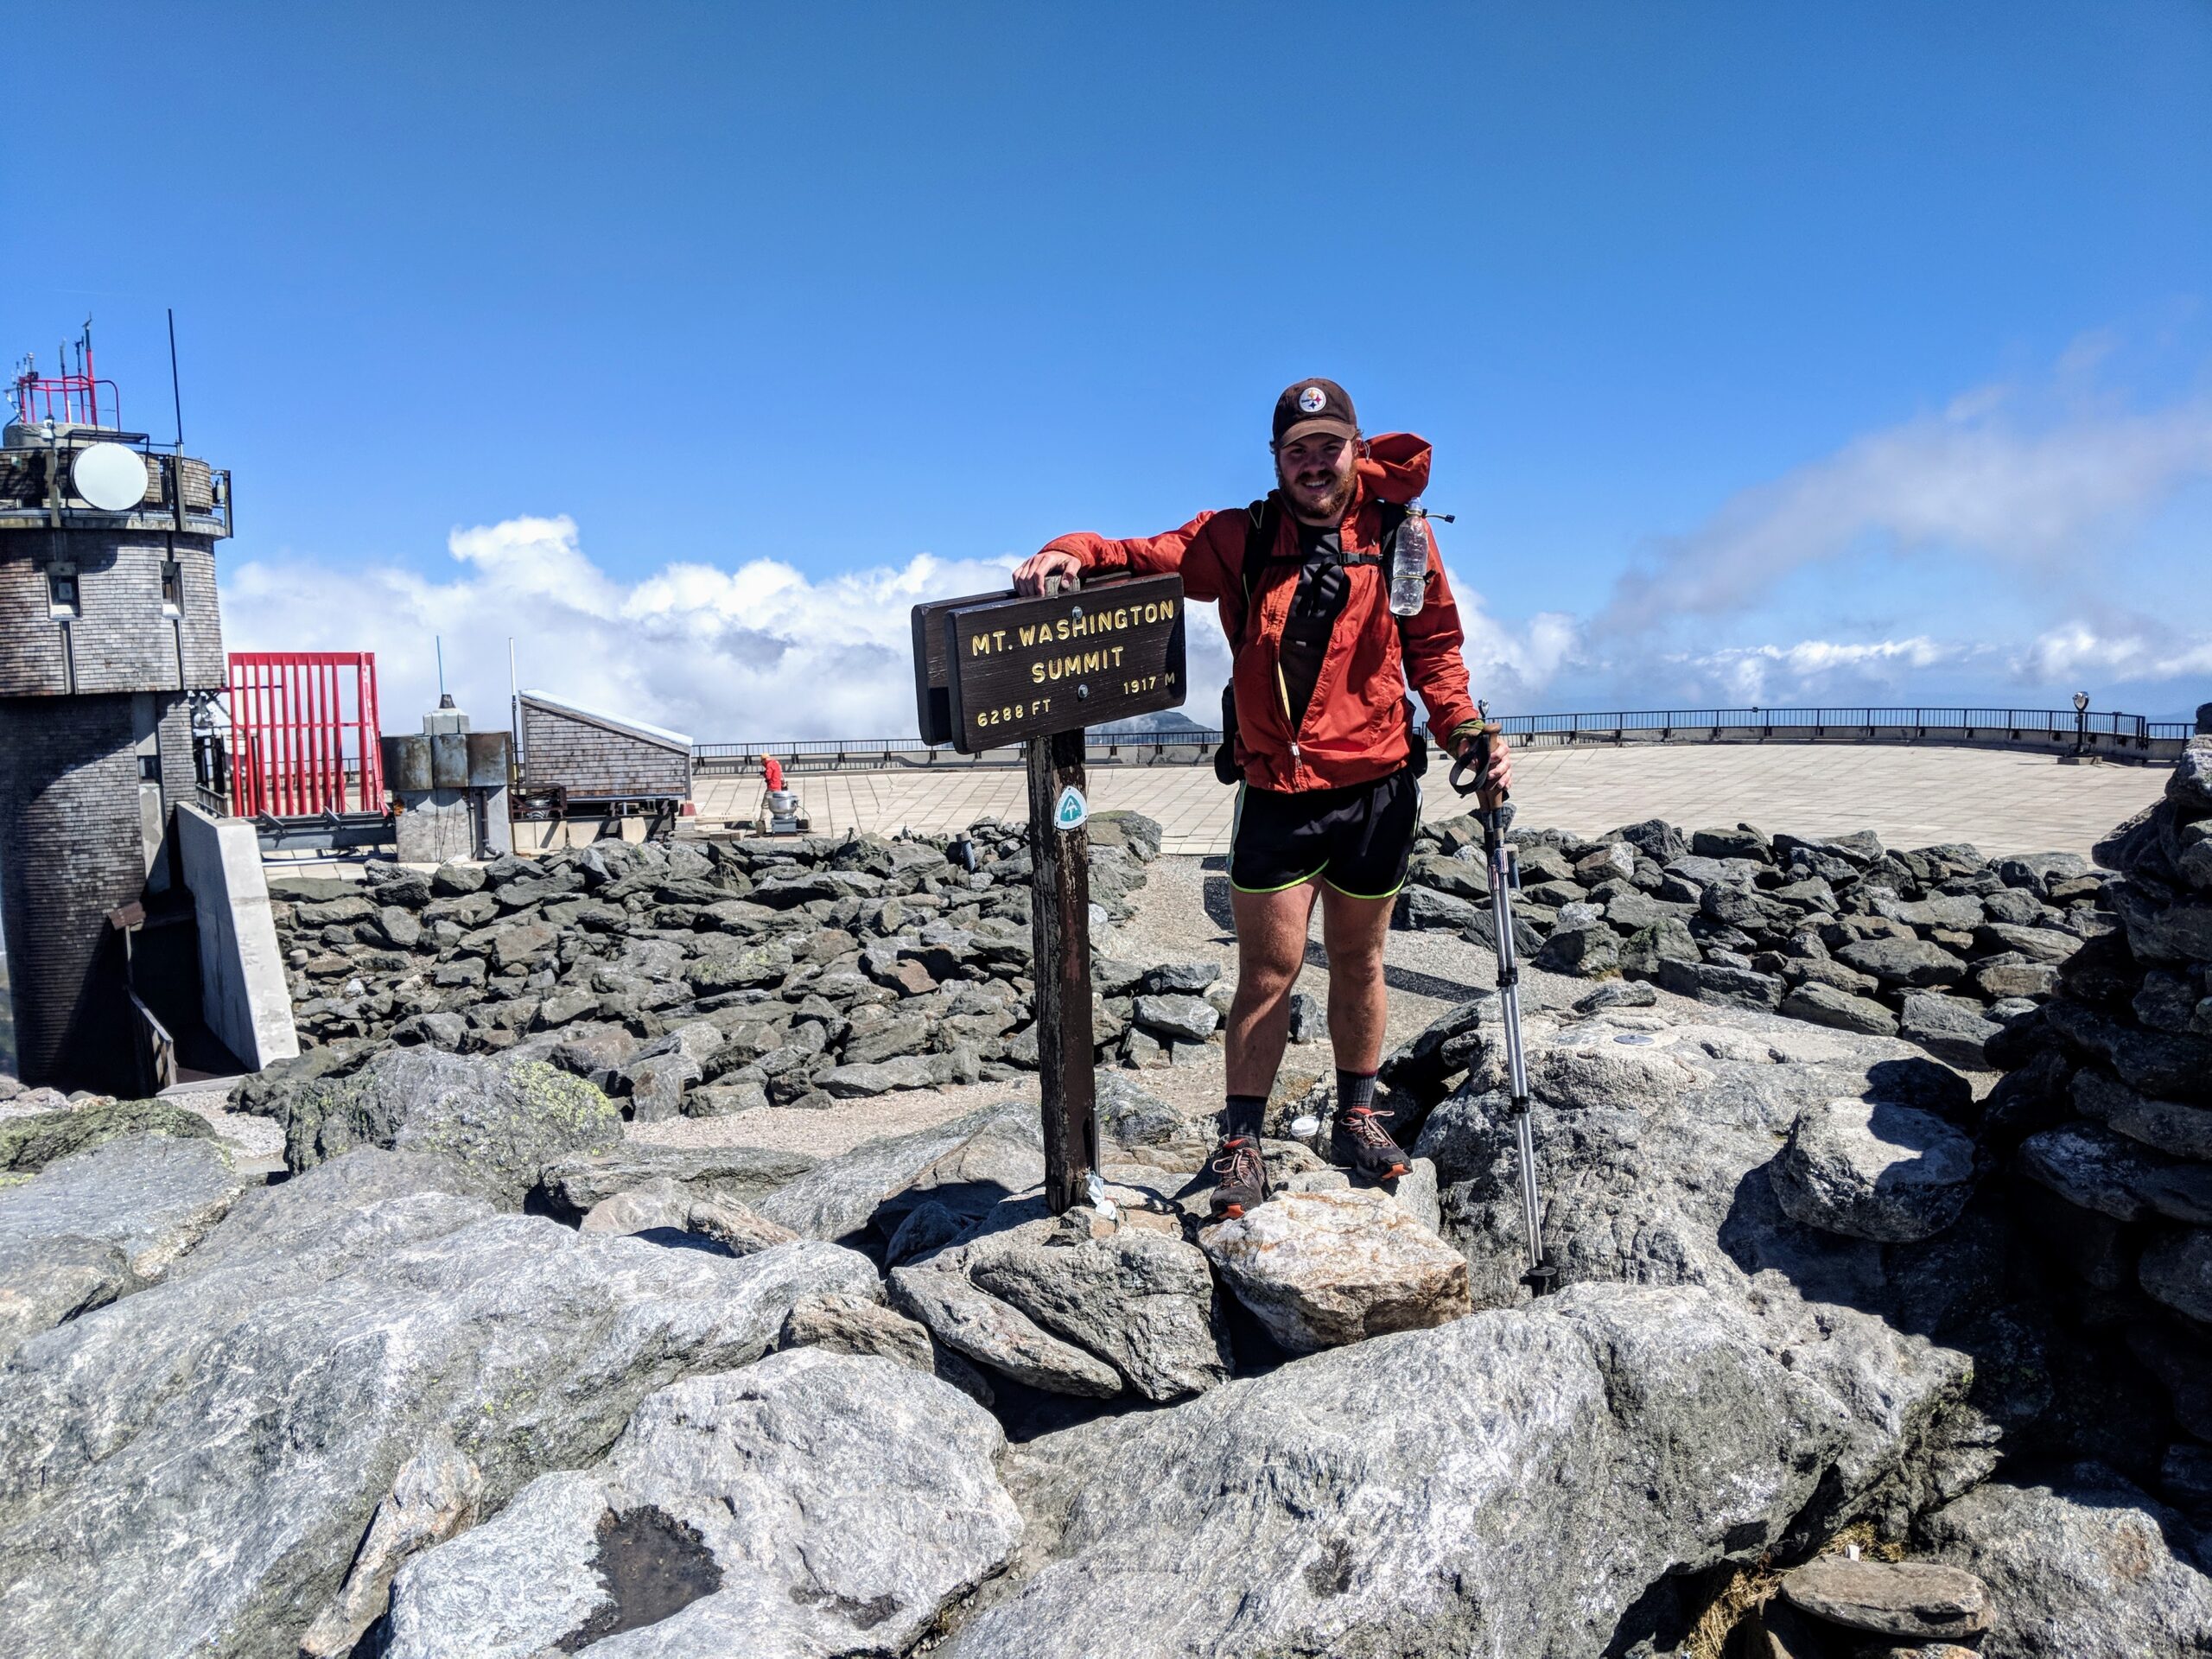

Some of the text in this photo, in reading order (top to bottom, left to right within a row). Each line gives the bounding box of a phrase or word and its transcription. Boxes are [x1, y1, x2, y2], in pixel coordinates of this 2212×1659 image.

[972, 599, 1174, 657] MT. WASHINGTON
[1032, 645, 1123, 683] SUMMIT
[977, 672, 1175, 727] 6288 FT 1917 M
